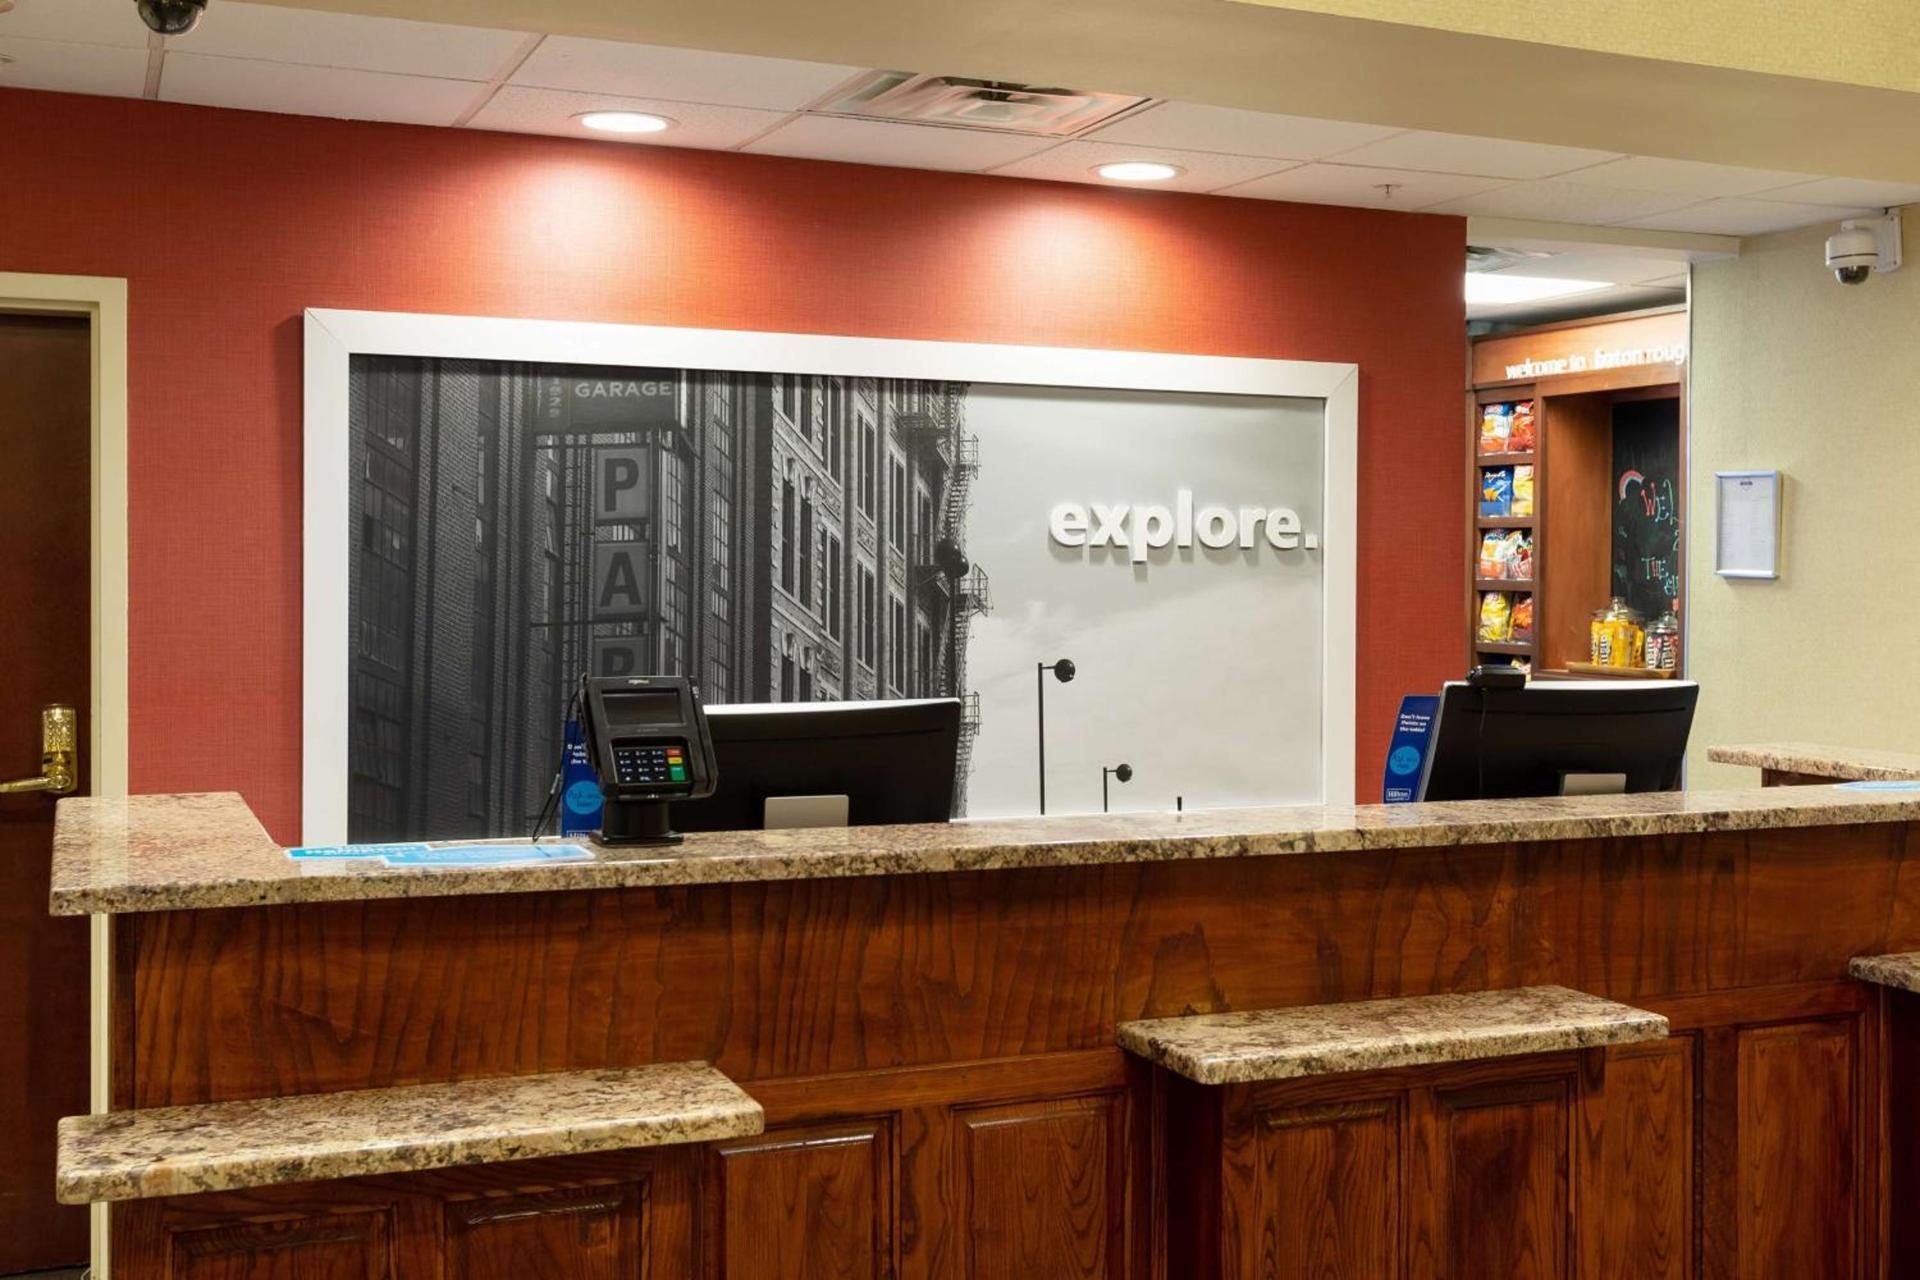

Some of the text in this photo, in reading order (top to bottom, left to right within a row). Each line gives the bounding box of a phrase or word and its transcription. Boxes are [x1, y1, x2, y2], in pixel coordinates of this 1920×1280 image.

[1646, 343, 1687, 366] roug
[575, 381, 673, 398] GARAGE
[1050, 488, 1319, 562] explore.
